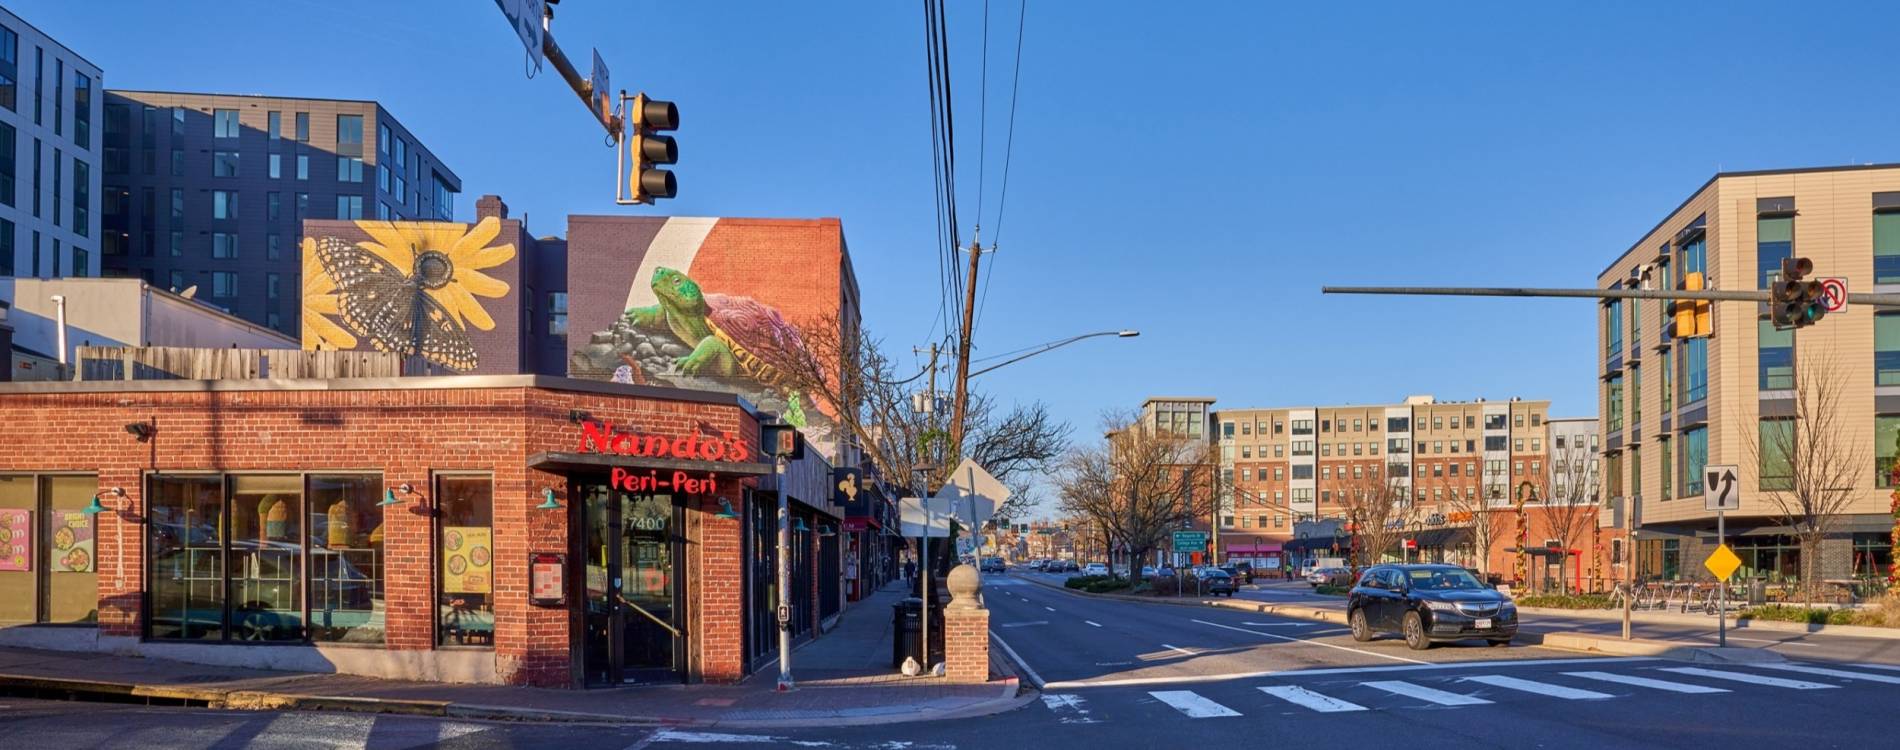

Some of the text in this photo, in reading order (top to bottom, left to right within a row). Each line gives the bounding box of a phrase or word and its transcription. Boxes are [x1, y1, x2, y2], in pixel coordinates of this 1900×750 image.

[577, 420, 749, 462] Nando's
[611, 467, 716, 494] Peri-Peri
[629, 517, 665, 530] 7400
